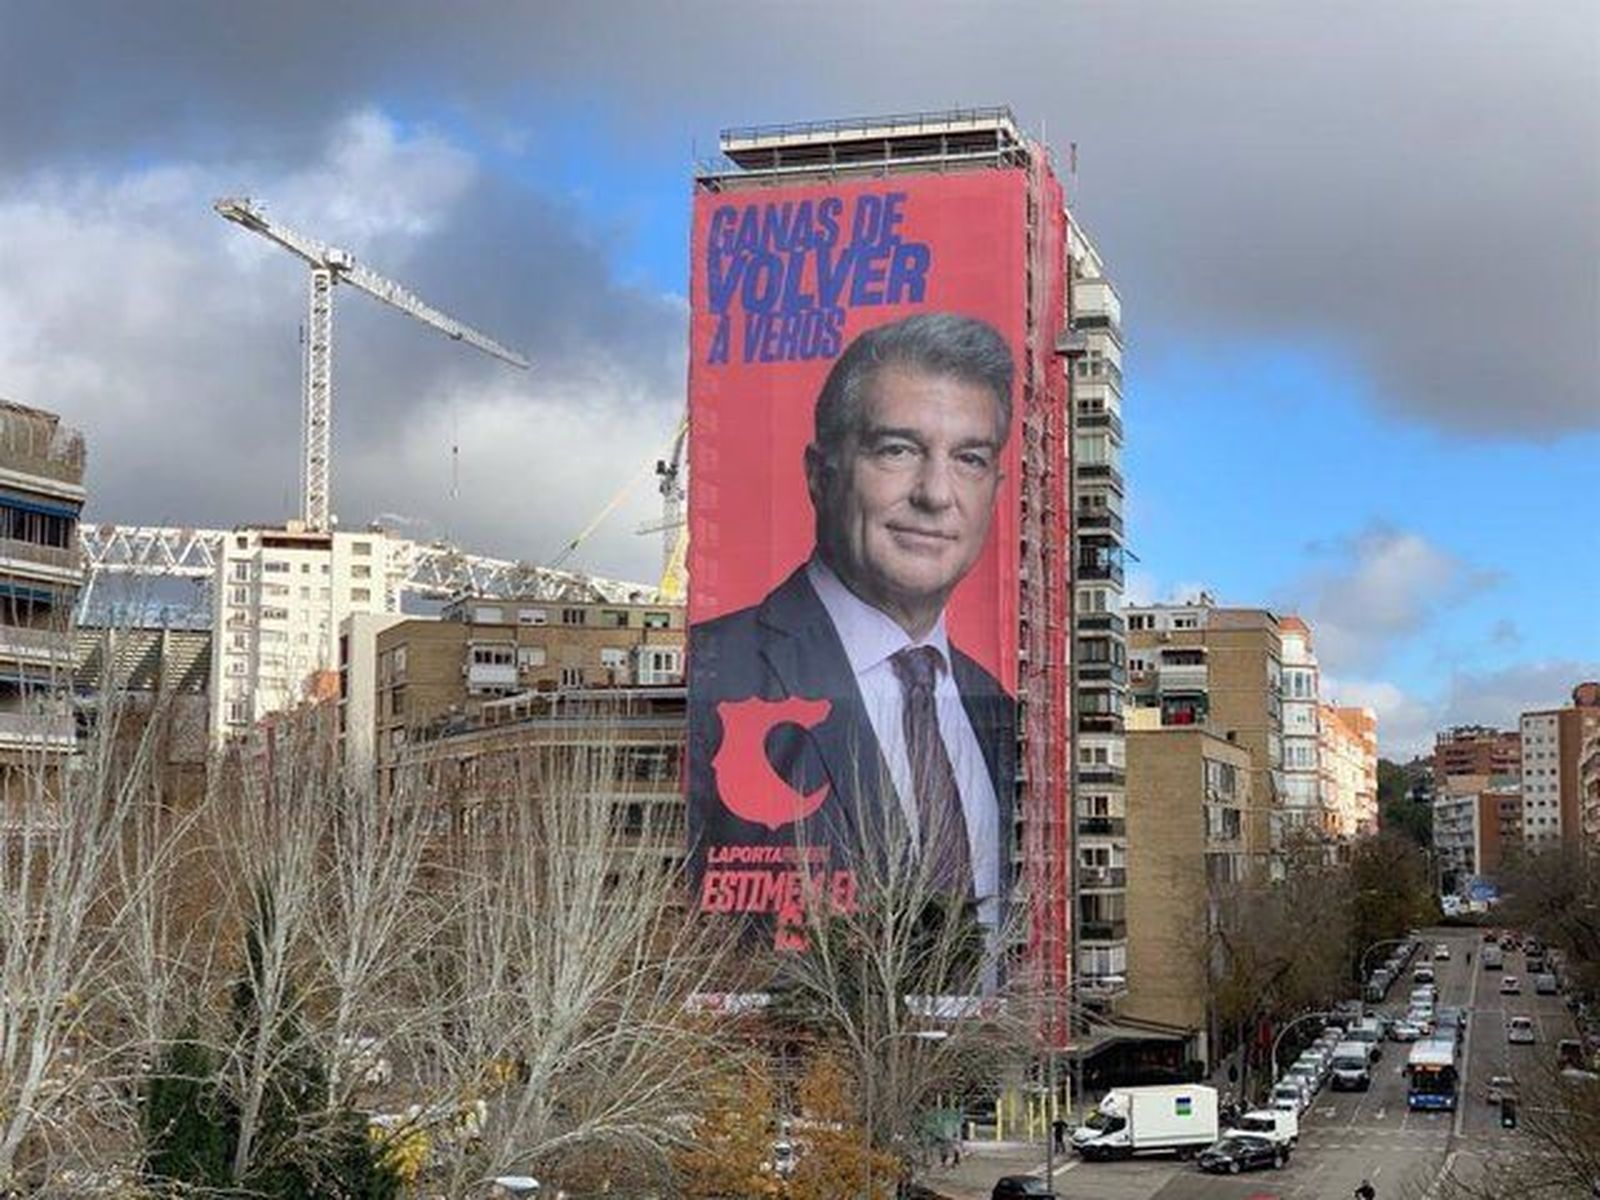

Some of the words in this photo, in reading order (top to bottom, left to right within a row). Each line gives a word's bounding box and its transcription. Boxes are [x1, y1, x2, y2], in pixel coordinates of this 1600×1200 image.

[709, 197, 843, 252] GANAS
[853, 192, 907, 246] DE
[707, 242, 931, 314] VOLVER
[707, 313, 730, 364] A
[744, 307, 845, 363] VEROS
